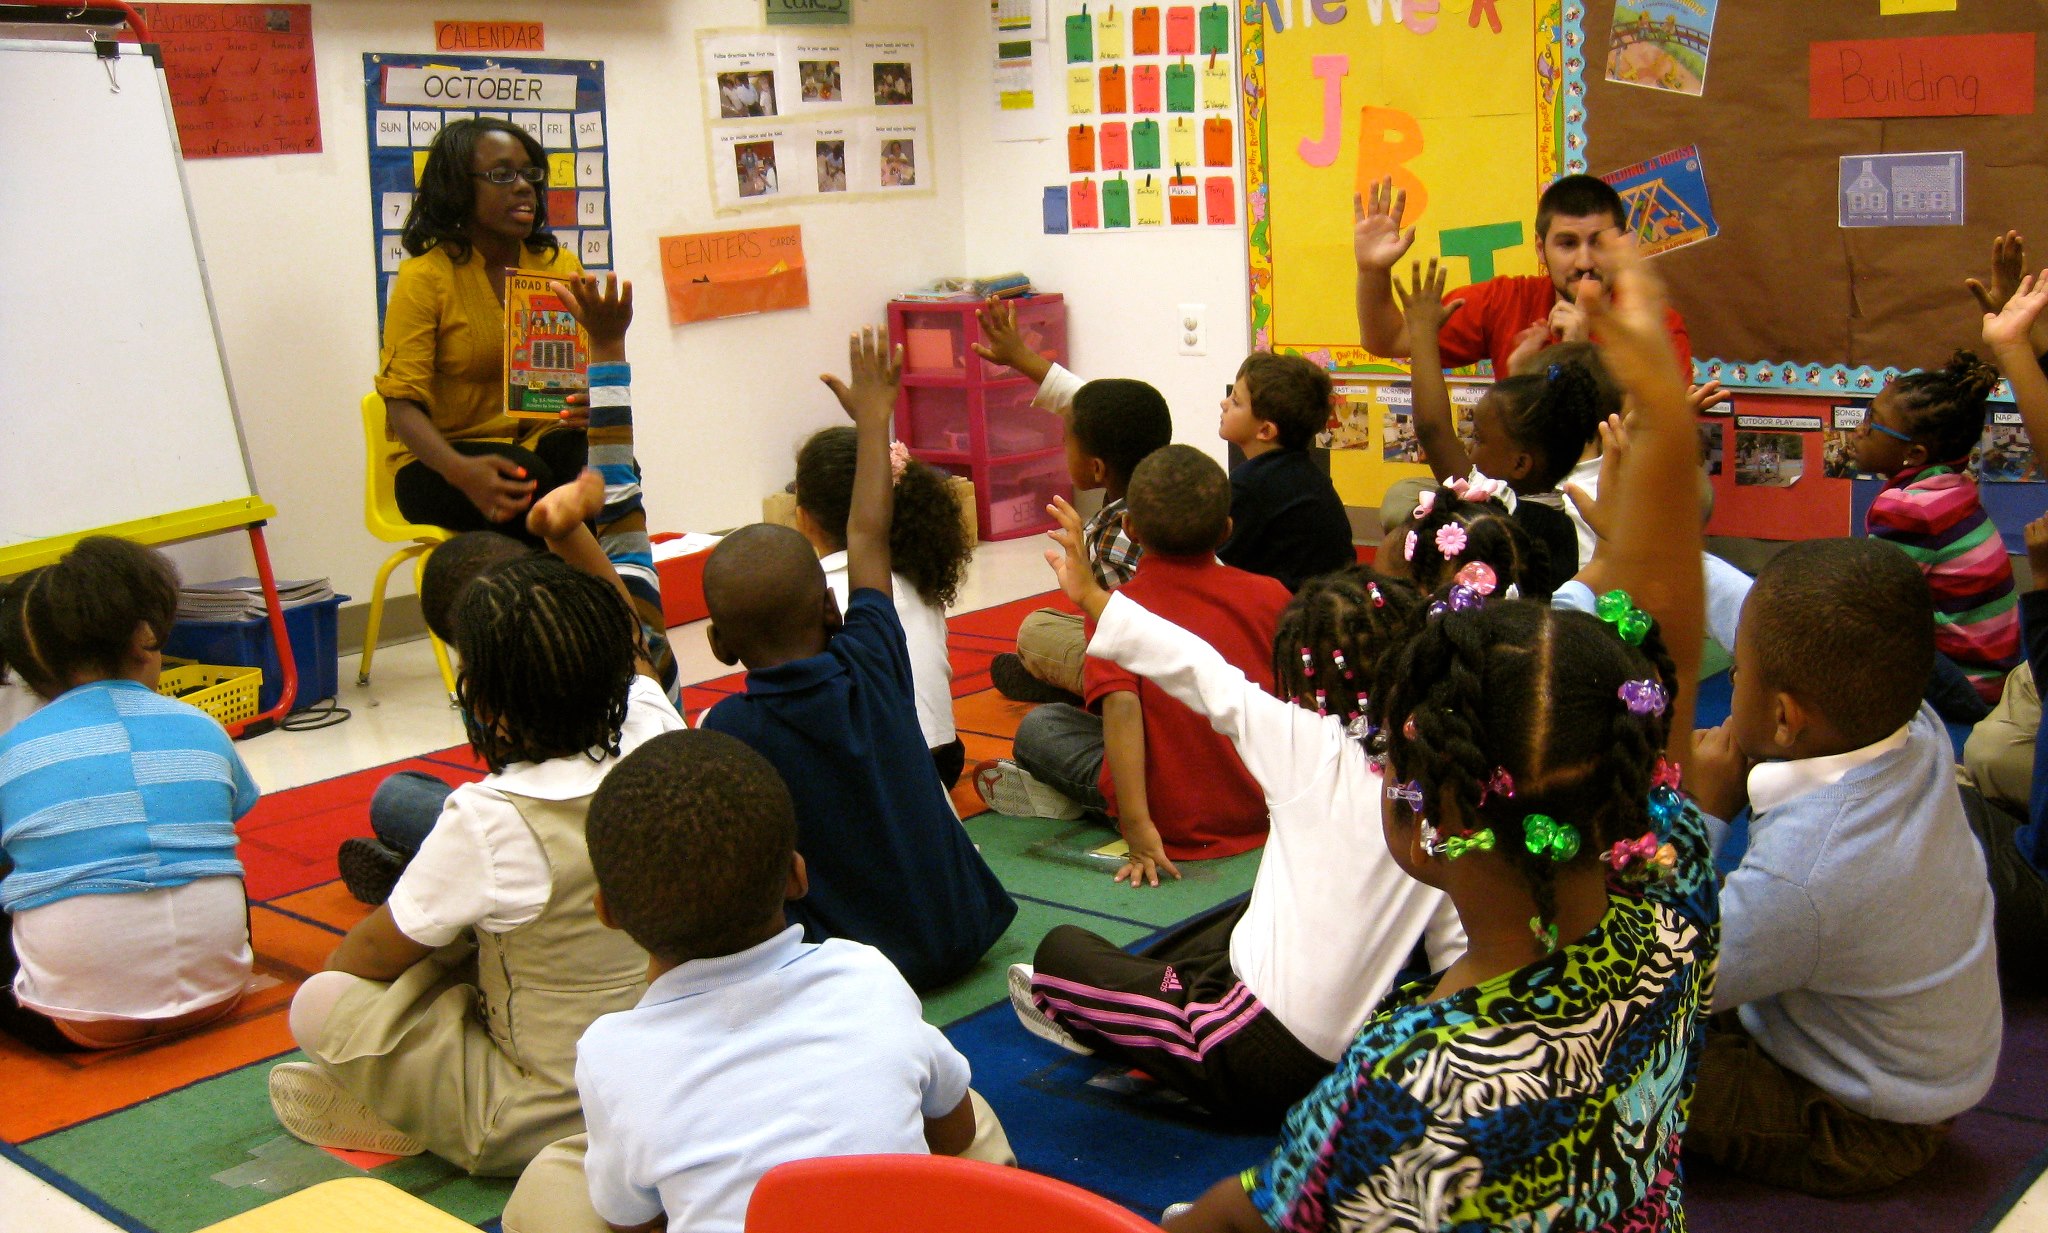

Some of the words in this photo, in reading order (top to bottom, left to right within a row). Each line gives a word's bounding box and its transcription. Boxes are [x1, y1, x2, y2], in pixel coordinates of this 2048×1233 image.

[438, 23, 543, 50] CALENDAR
[424, 73, 544, 101] OCTOBER
[1839, 47, 1979, 115] Building
[1297, 54, 1350, 168] J
[380, 123, 401, 133] SUN
[412, 122, 438, 132] MON
[547, 124, 563, 134] FRI
[585, 164, 593, 176] 6
[1353, 105, 1429, 230] B
[1600, 161, 1647, 185] UILDING
[1658, 144, 1697, 167] HOUSE
[1207, 185, 1225, 198] Tony
[393, 205, 401, 217] 7
[585, 202, 595, 214] 13
[1209, 214, 1225, 226] Tony
[390, 247, 403, 260] 14
[587, 241, 601, 253] 20
[667, 231, 763, 270] CENTERS
[769, 235, 798, 249] CARDS
[1438, 221, 1524, 285] T
[513, 278, 542, 293] ROAD
[1376, 396, 1402, 404] CENTERS
[1738, 417, 1774, 426] OUTDOOR
[1775, 418, 1794, 426] PLAY
[1835, 409, 1862, 418] SONGS,
[1160, 965, 1173, 993] adidas
